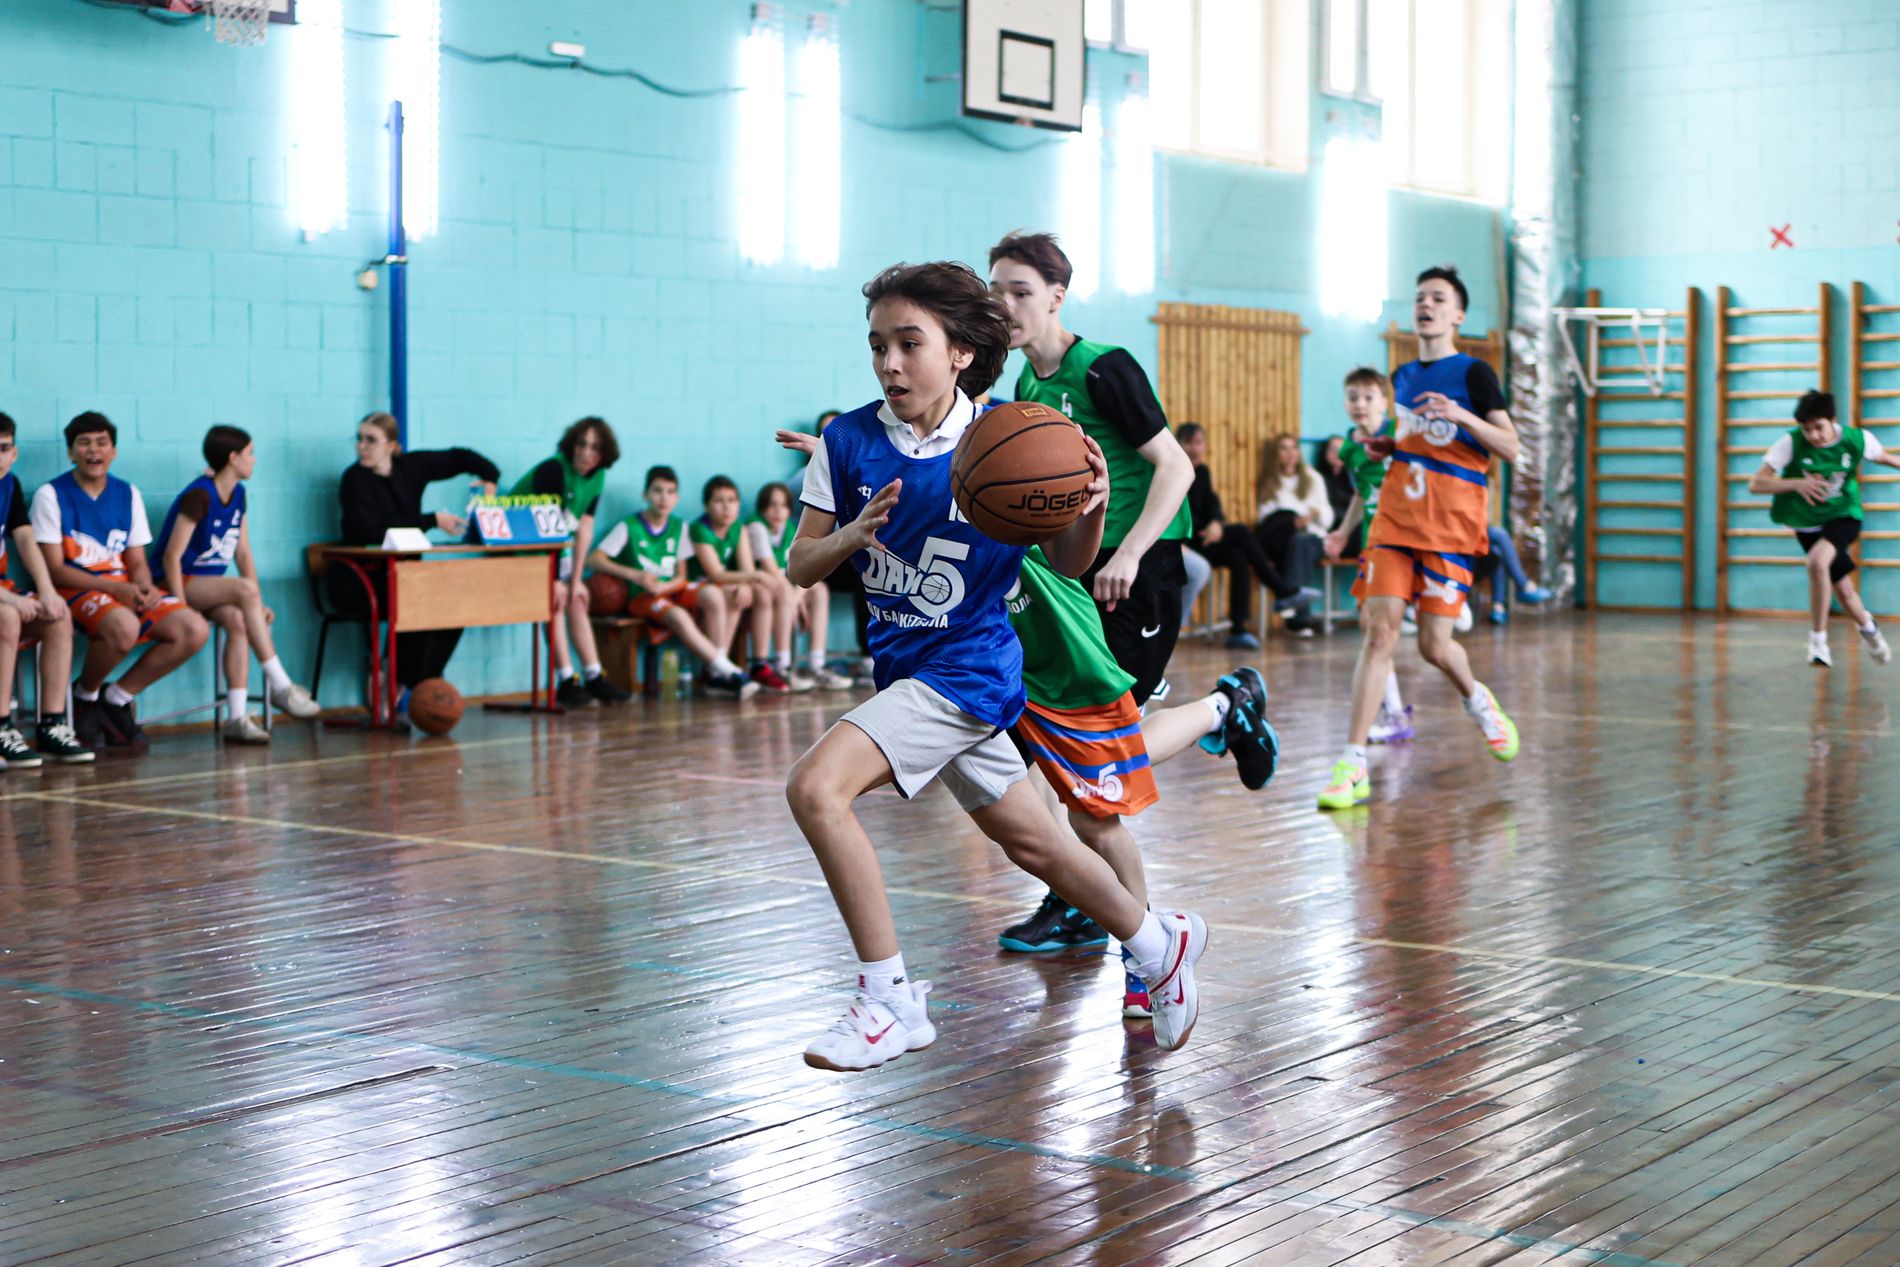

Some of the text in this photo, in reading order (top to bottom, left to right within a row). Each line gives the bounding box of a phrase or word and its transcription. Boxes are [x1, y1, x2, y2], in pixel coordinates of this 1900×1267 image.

[1061, 392, 1073, 418] 4
[1404, 460, 1426, 500] 3
[907, 536, 971, 618] 5
[1097, 761, 1124, 803] 5
